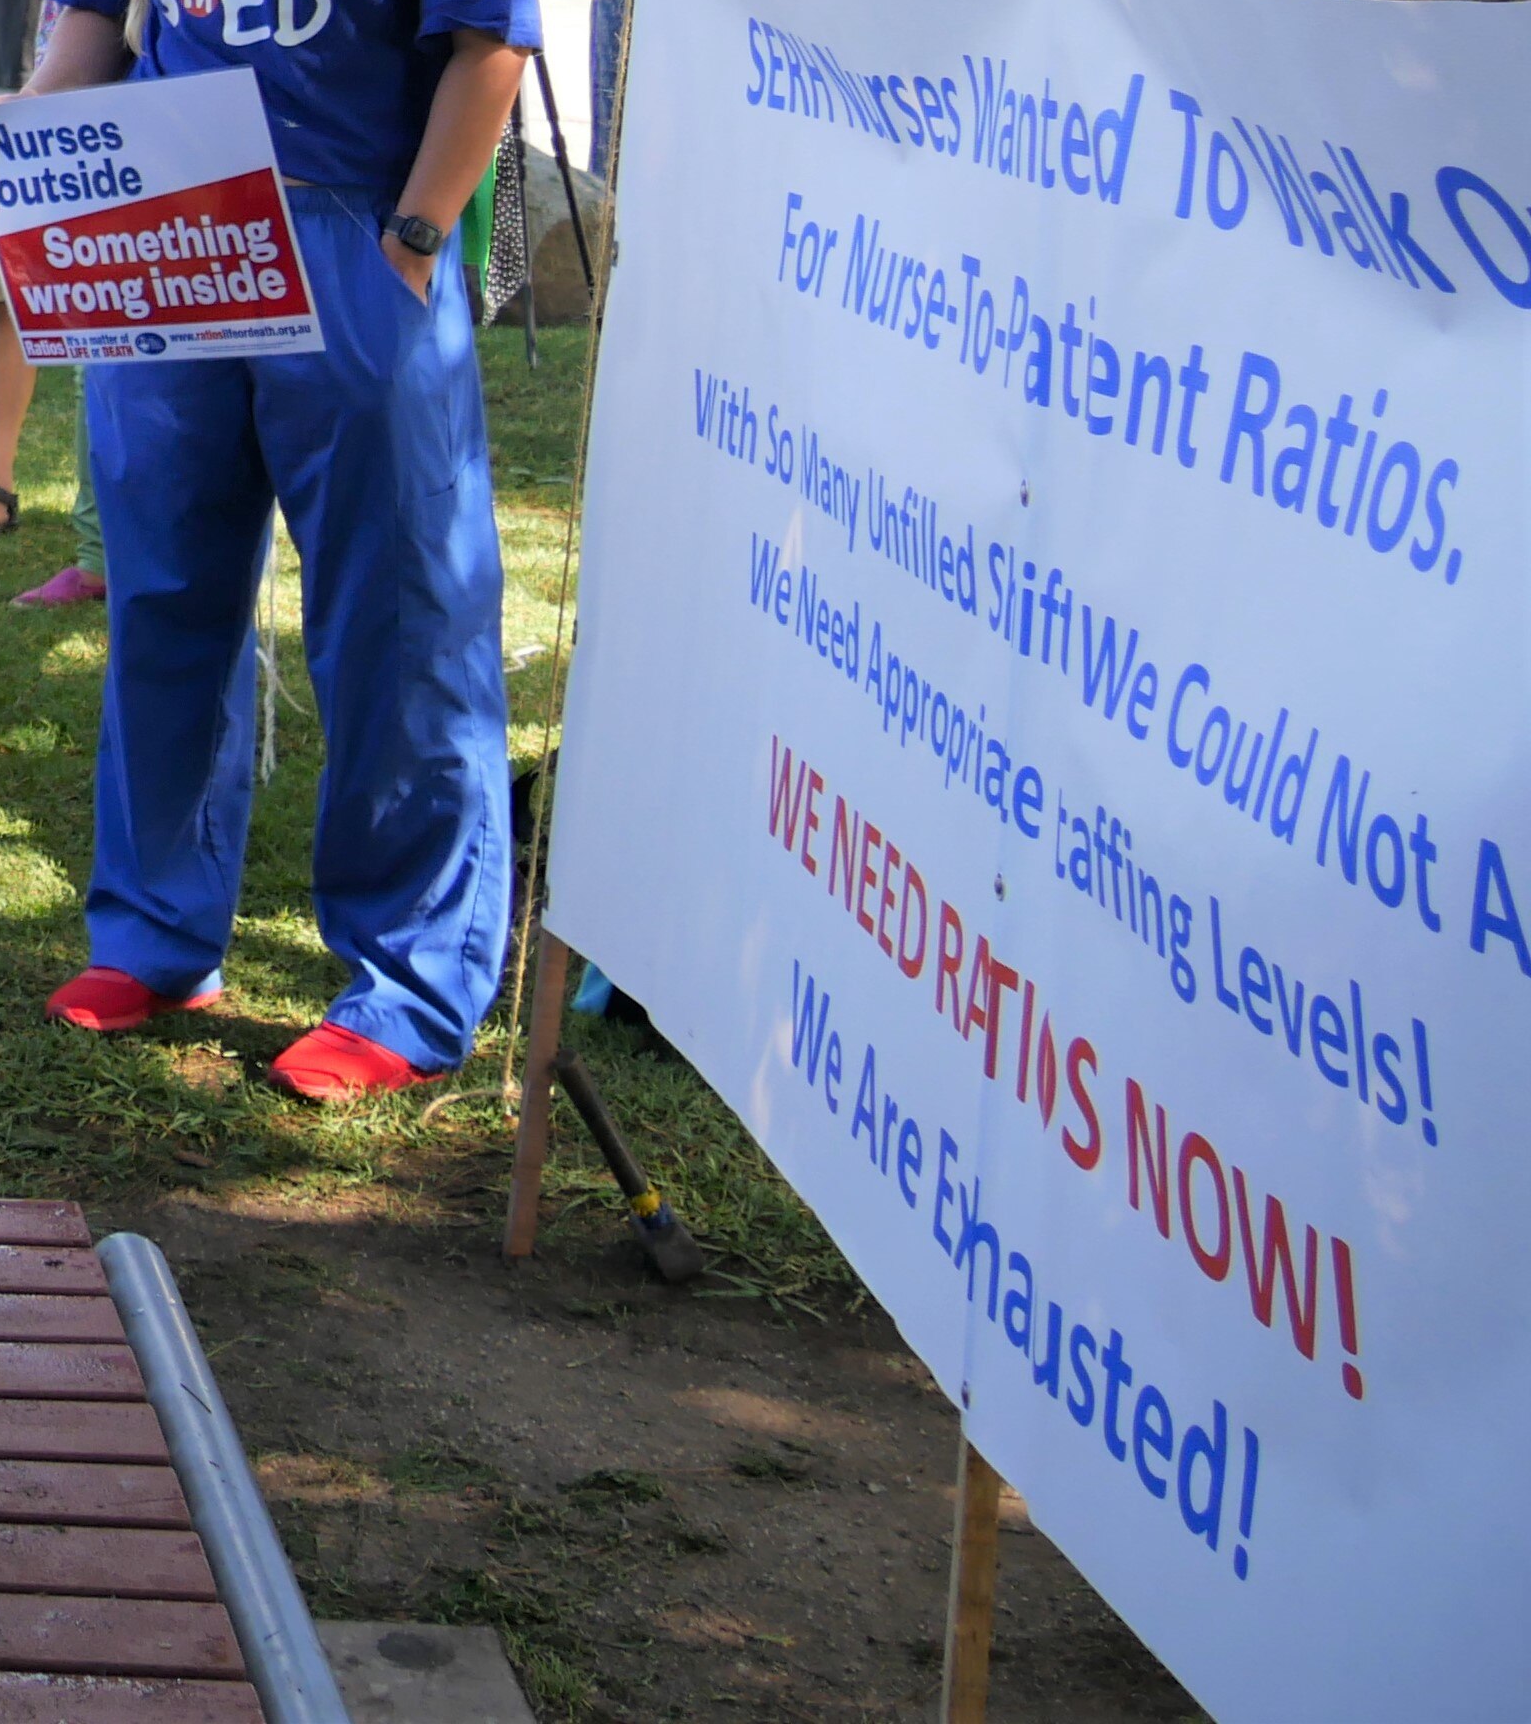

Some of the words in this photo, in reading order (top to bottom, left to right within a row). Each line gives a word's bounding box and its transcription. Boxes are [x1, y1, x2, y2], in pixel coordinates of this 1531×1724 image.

[19, 277, 151, 320] wrong
[149, 260, 287, 308] inside
[42, 214, 279, 270] Something
[811, 43, 961, 157] Nurses
[962, 54, 1144, 206] Wanted
[1169, 89, 1249, 231] To
[1231, 116, 1456, 293] Walk
[25, 338, 65, 357] Ratios
[102, 346, 134, 357] DEATH
[169, 324, 311, 343] www.ratioslifeordeath.org.au
[778, 192, 838, 294] For
[1221, 351, 1464, 586] Ratios.
[695, 369, 757, 464] With
[765, 404, 794, 485] So
[800, 424, 860, 553] Many
[868, 467, 978, 616] Unfilled
[1082, 604, 1158, 740] We
[1167, 663, 1318, 845] Could
[1316, 754, 1441, 933] Not
[750, 531, 791, 626] We
[796, 565, 860, 684] Need
[1056, 787, 1196, 1003] taffing
[1209, 896, 1438, 1148] Levels!
[768, 734, 824, 876] WE
[827, 793, 927, 980] NEED
[1125, 1076, 1364, 1400] NOW!
[790, 958, 842, 1116] We
[851, 1043, 923, 1211] Are
[932, 1126, 1260, 1581] Exhausted!
